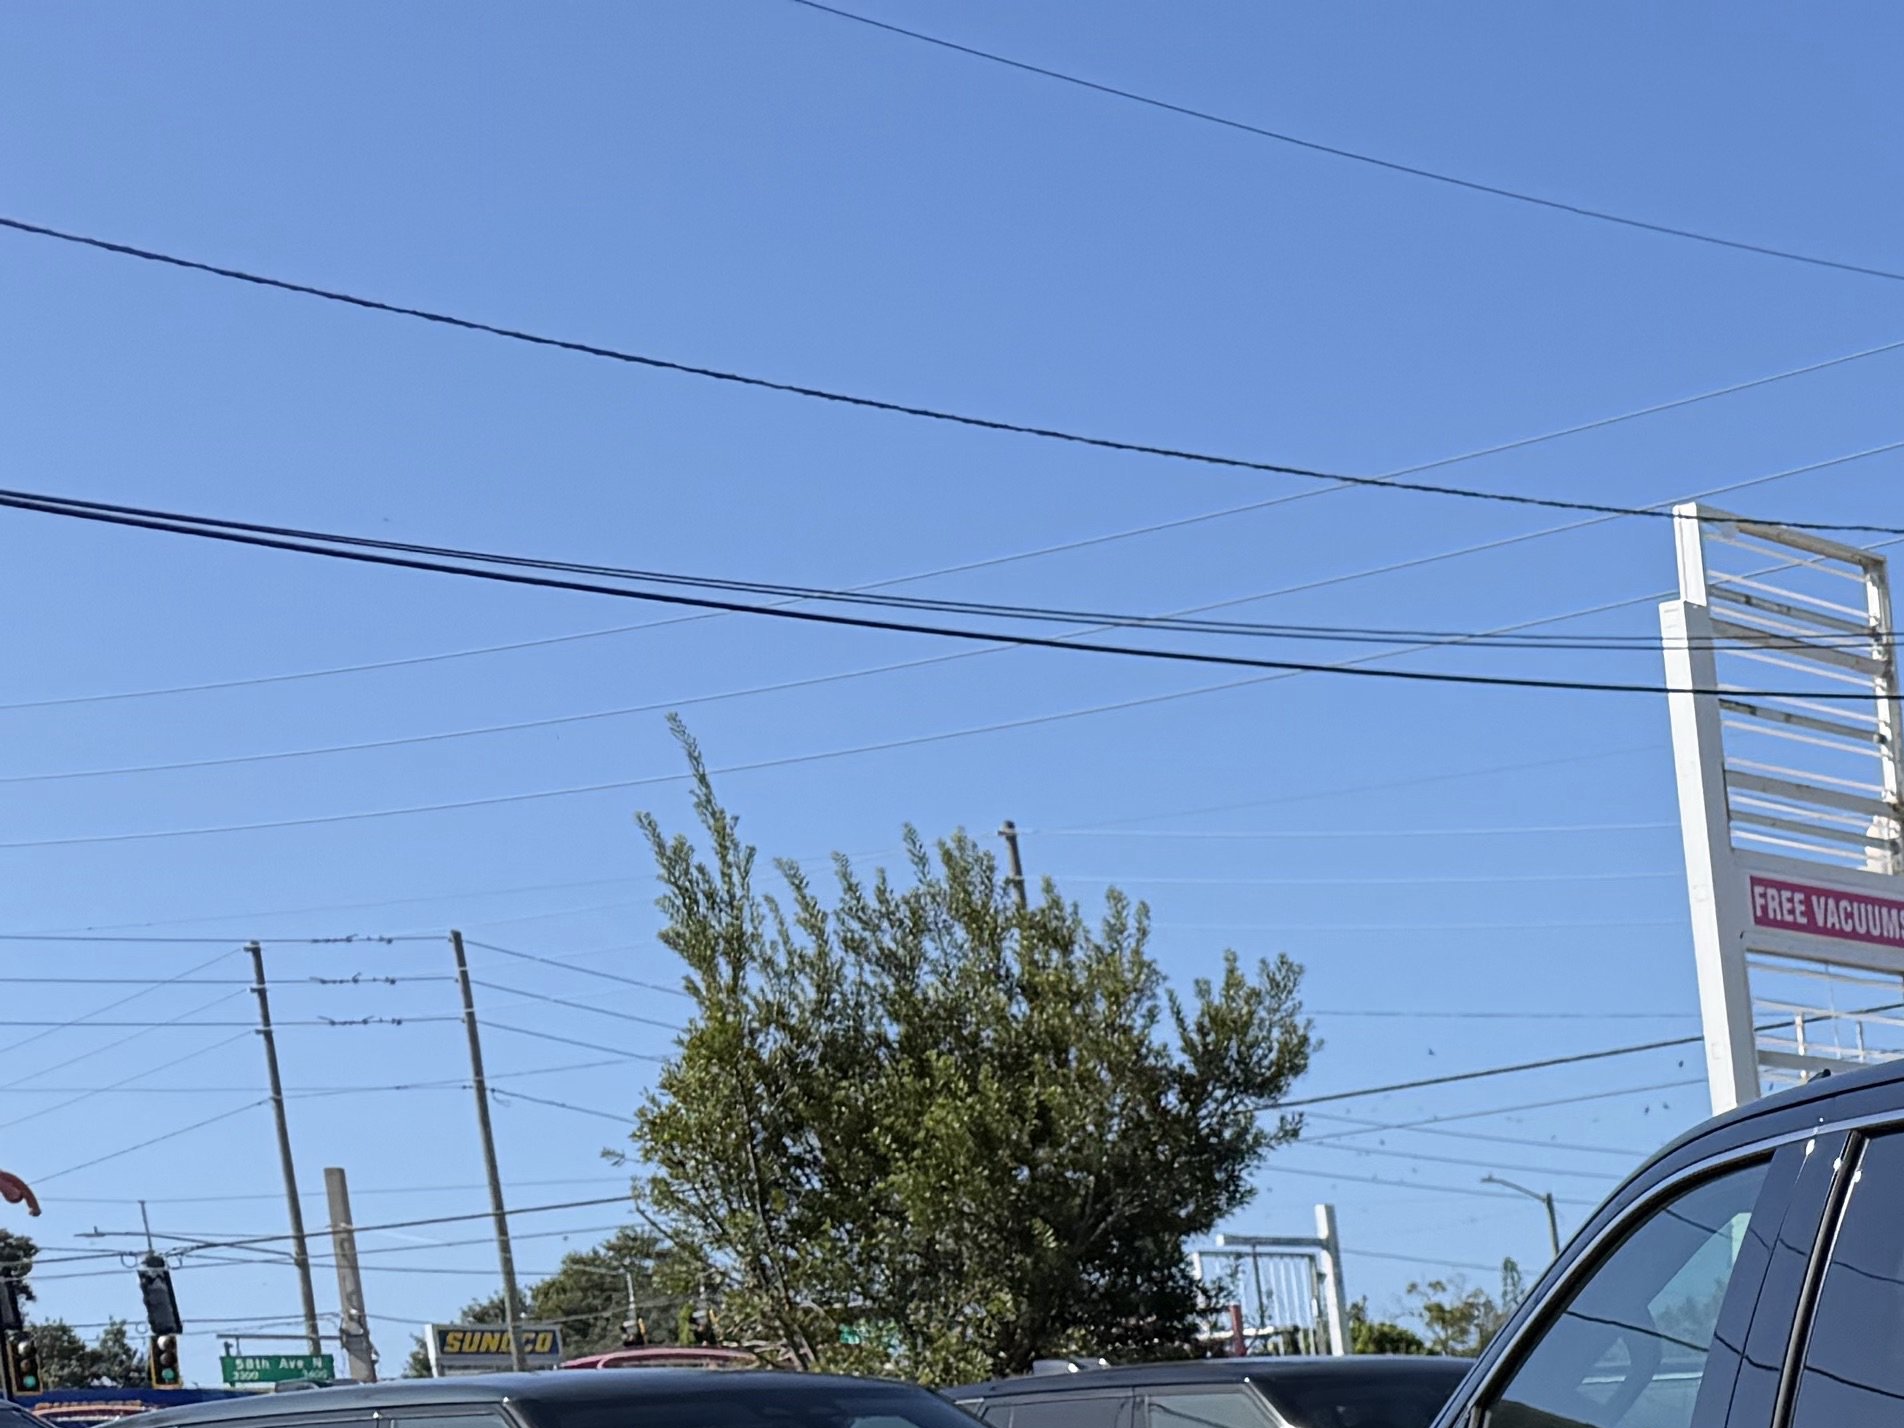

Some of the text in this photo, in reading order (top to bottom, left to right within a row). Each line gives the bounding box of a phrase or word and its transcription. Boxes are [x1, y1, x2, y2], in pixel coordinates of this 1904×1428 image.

[1753, 884, 1808, 925] FREE
[235, 1357, 323, 1370] 58th Ave N
